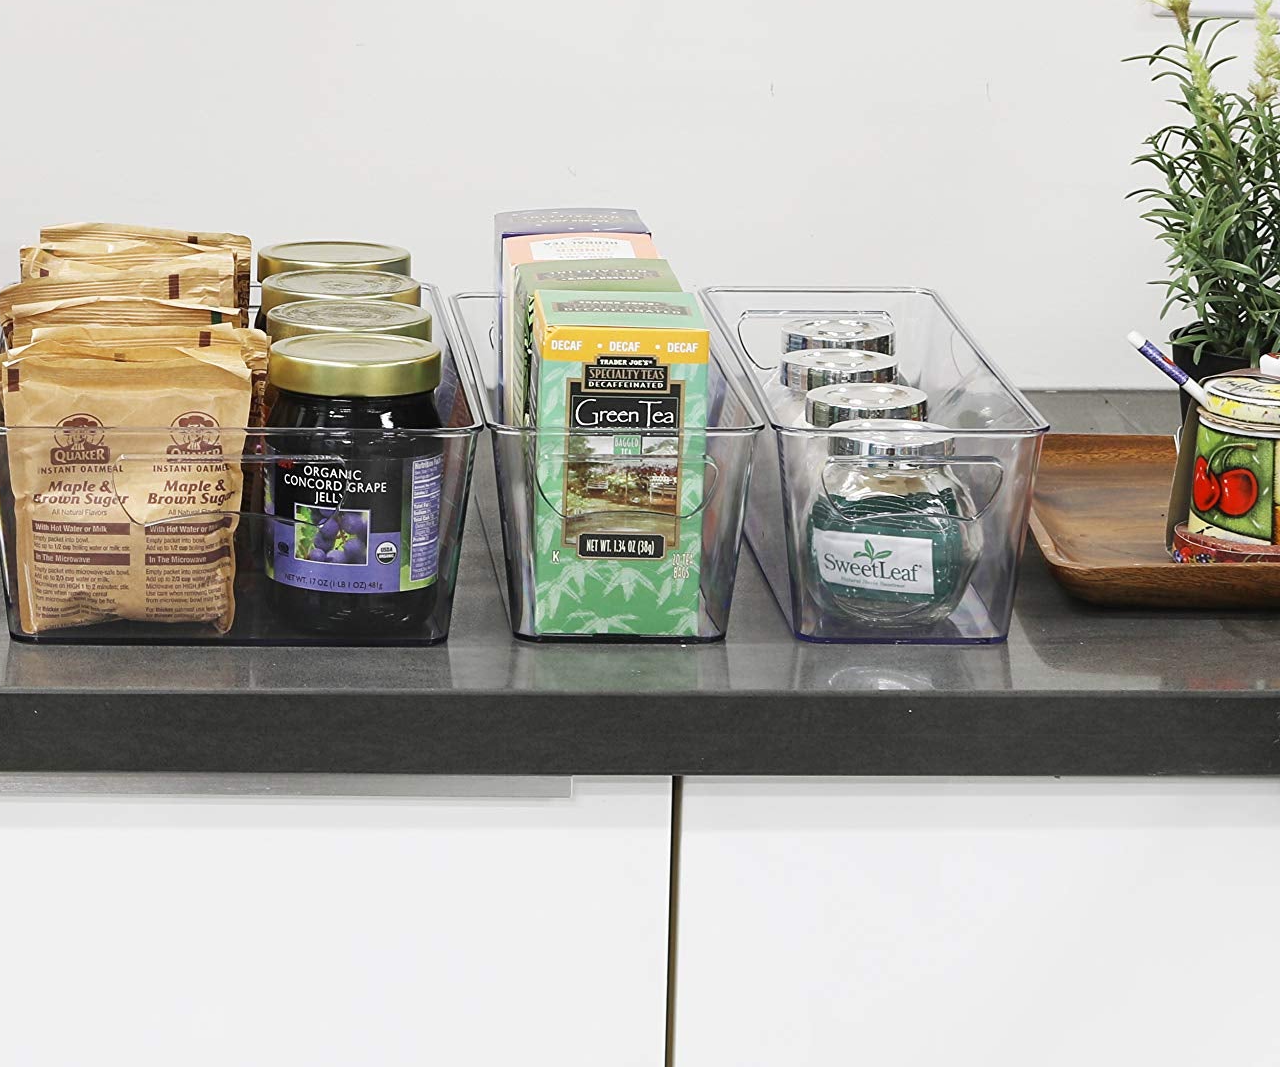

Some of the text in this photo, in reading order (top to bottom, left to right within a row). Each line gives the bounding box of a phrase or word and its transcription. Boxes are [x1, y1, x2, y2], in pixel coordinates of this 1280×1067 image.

[552, 340, 698, 353] DECAF DECAF DECAF
[589, 369, 664, 379] SPECIALTY TEAS
[575, 399, 674, 428] Green Tea
[54, 449, 105, 463] QUAKER
[304, 465, 361, 480] ORGANIC
[49, 481, 111, 495] Maple &
[164, 479, 226, 495] Maple &
[284, 474, 387, 493] CONCORD GRAPE
[34, 494, 80, 504] Brown
[148, 493, 196, 504] Brown
[586, 539, 654, 555] NET WT. 1.34 OZ (38g)
[56, 555, 90, 563] Microwave
[552, 551, 560, 563] K
[824, 553, 918, 582] SweetLeaf
[353, 582, 366, 590] OZ)
